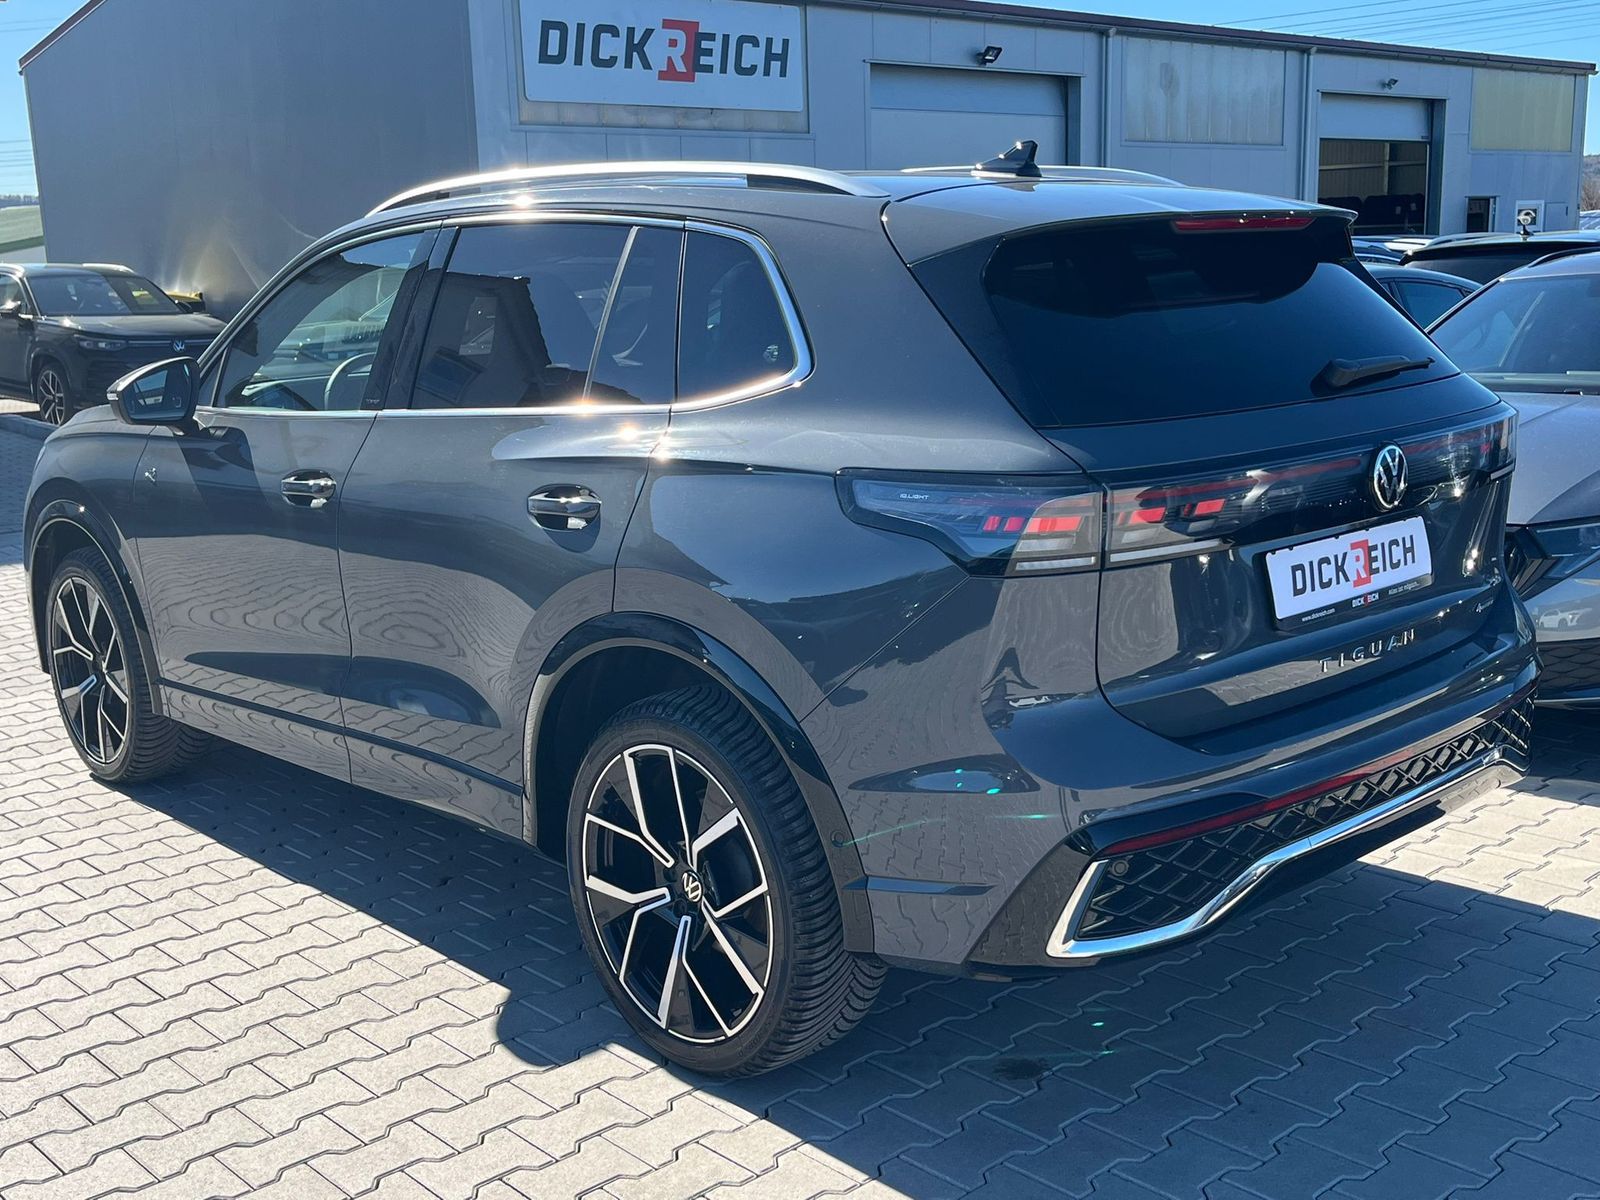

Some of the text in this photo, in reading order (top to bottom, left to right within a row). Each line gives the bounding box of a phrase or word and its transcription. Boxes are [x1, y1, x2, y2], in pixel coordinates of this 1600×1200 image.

[538, 19, 790, 83] DICKREICH
[1290, 535, 1416, 597] DICKREICH
[1319, 628, 1415, 673] TIGUAN
